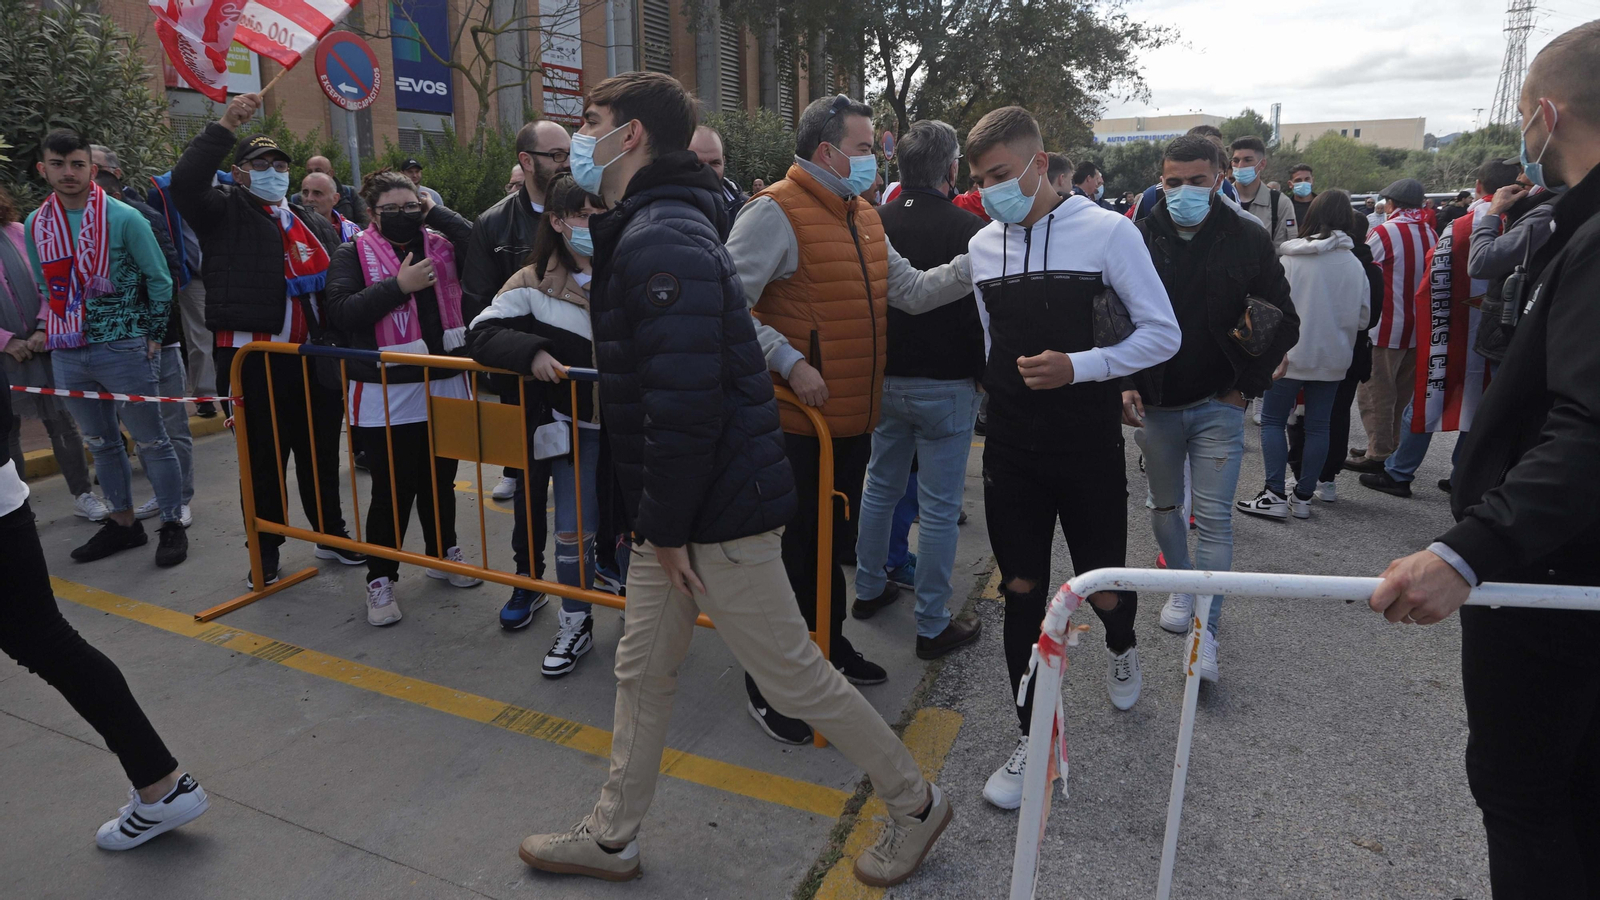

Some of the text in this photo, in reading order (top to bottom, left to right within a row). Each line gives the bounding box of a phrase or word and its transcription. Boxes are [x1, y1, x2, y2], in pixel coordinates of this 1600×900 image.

[320, 67, 380, 110] EXCEPTO DISCAPACITADOS
[396, 76, 448, 96] EVOS
[369, 266, 382, 282] ME
[1425, 235, 1453, 399] GECIRAS C.F.
